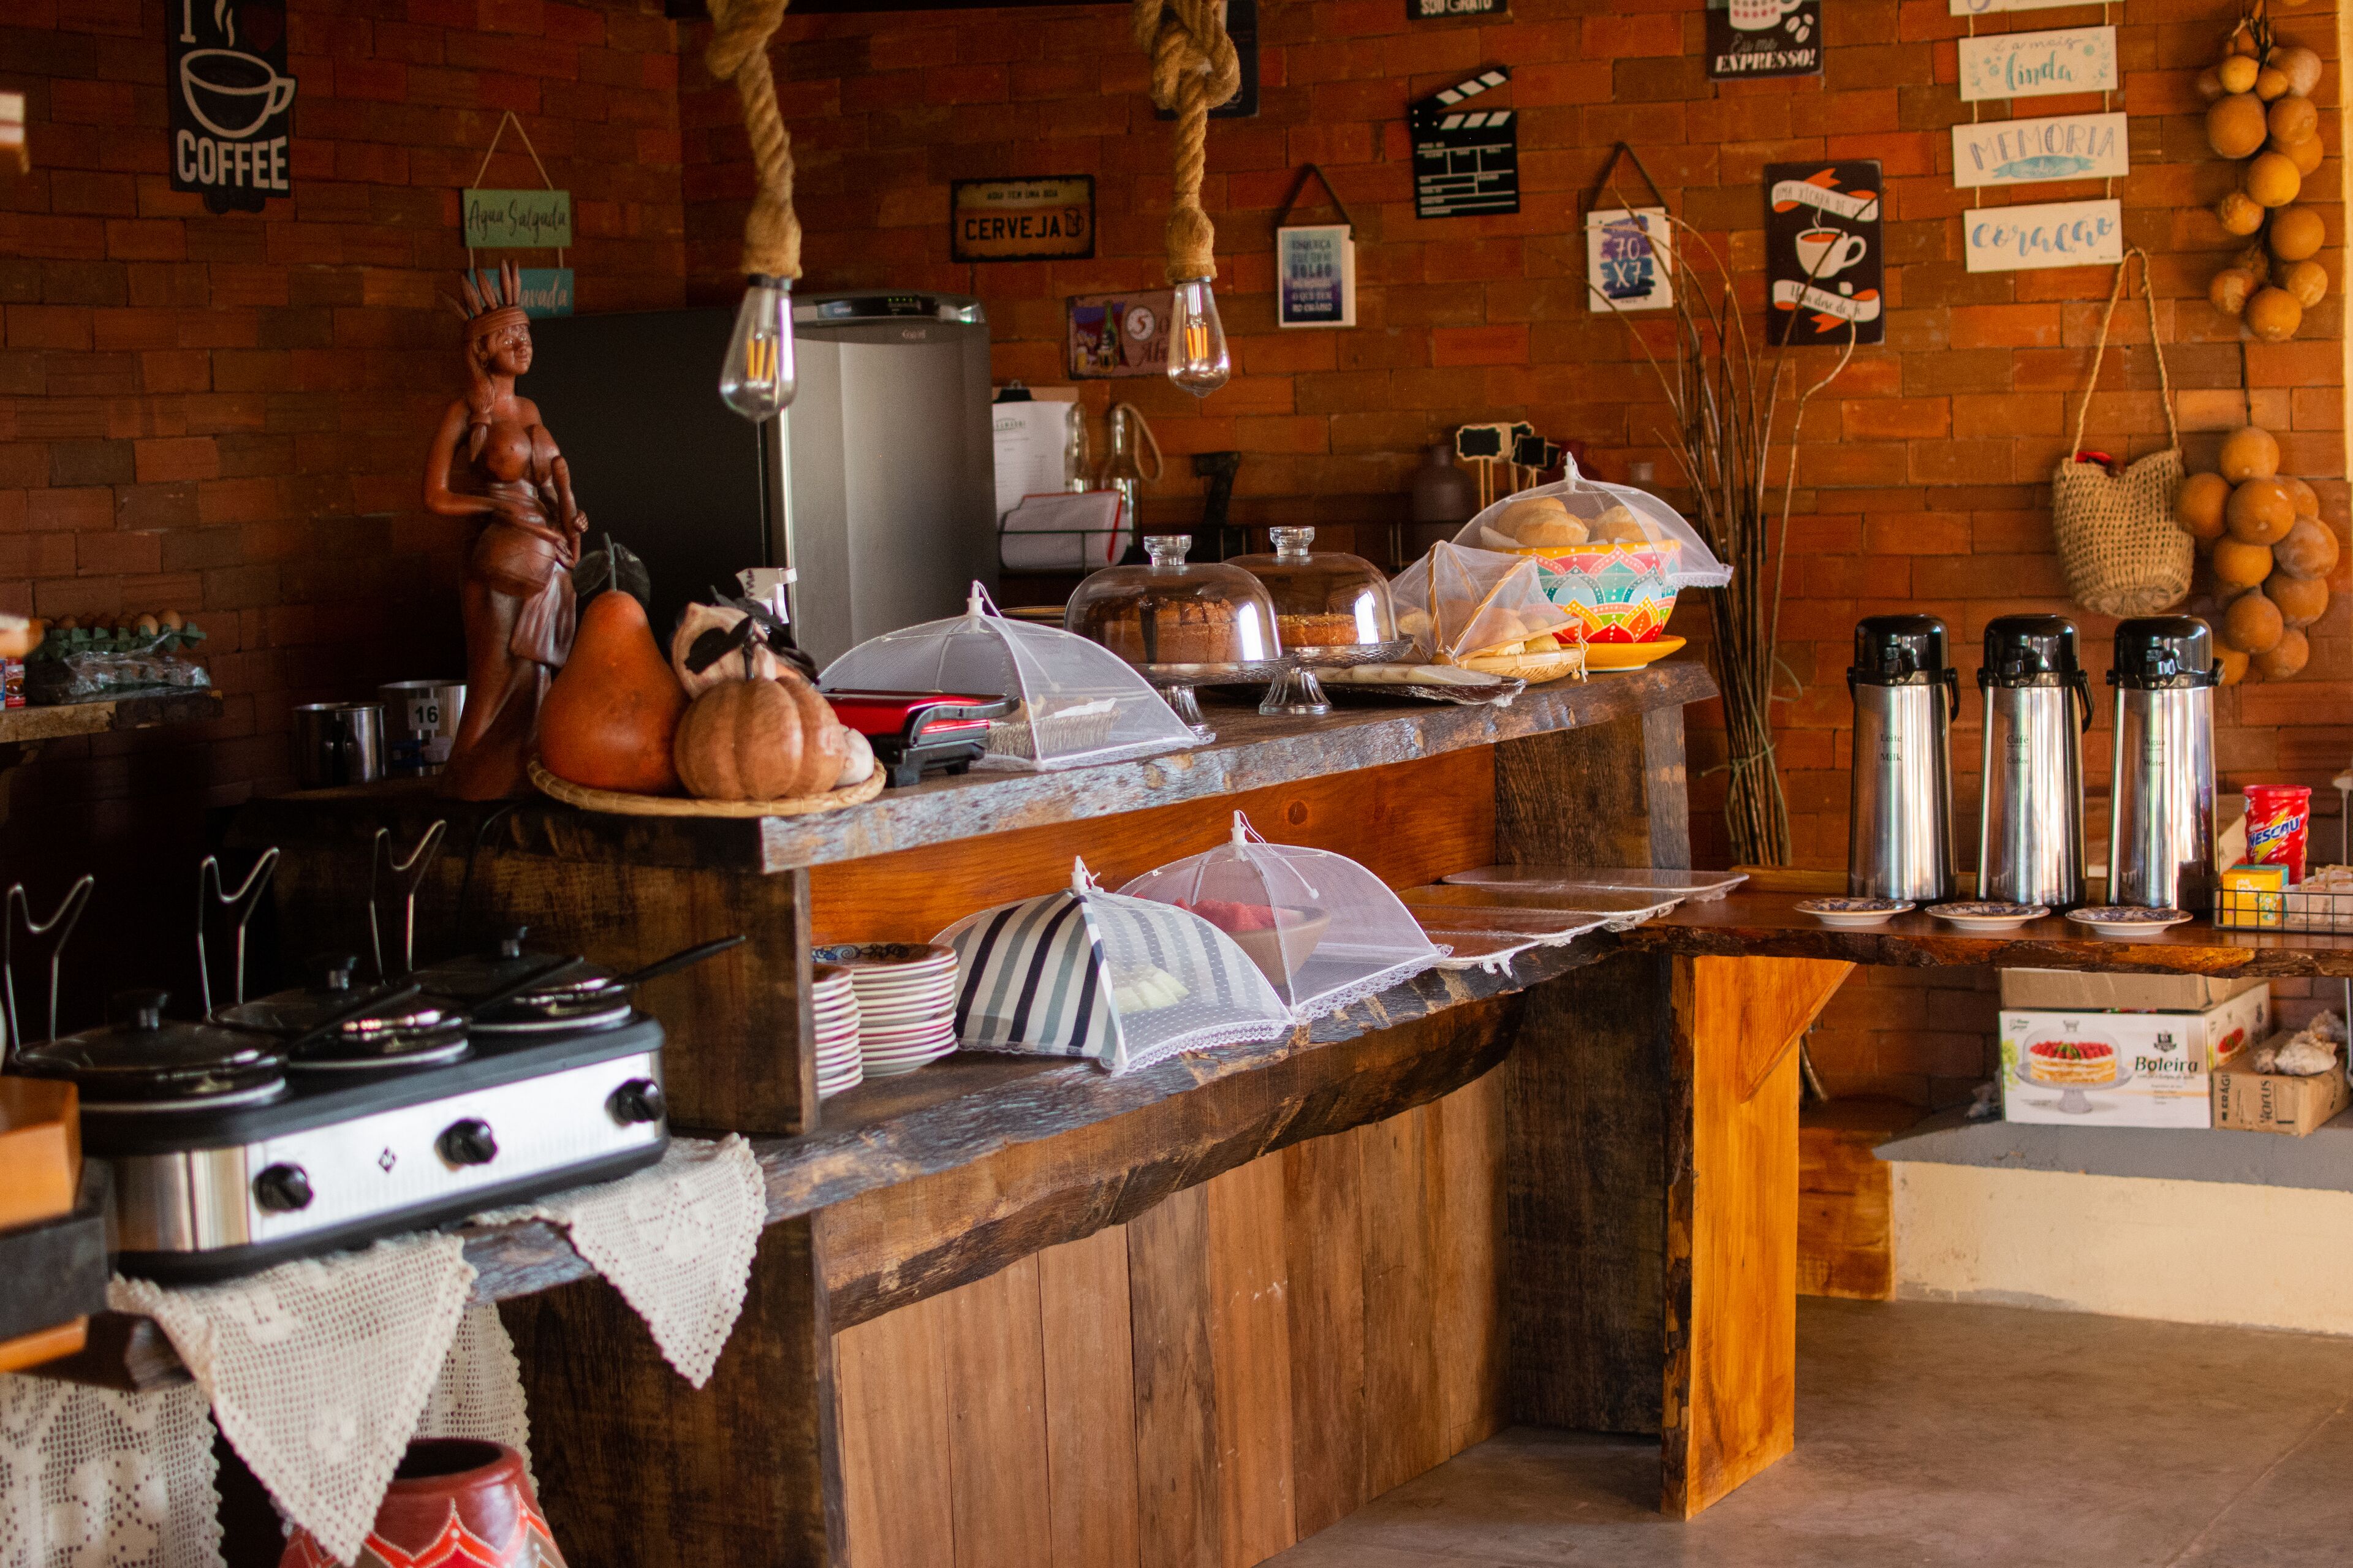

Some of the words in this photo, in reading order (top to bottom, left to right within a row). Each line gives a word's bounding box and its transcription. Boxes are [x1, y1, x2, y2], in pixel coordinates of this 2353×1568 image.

[1716, 48, 1816, 72] EXPRESSO!
[177, 129, 289, 190] COFFEE
[965, 216, 1062, 240] CERVEJA
[1613, 237, 1640, 261] 70
[1613, 261, 1642, 289] X7
[416, 706, 438, 723] 16
[2007, 735, 2029, 744] Café
[2248, 817, 2300, 848] NESCAU
[2135, 1056, 2198, 1072] Boleira
